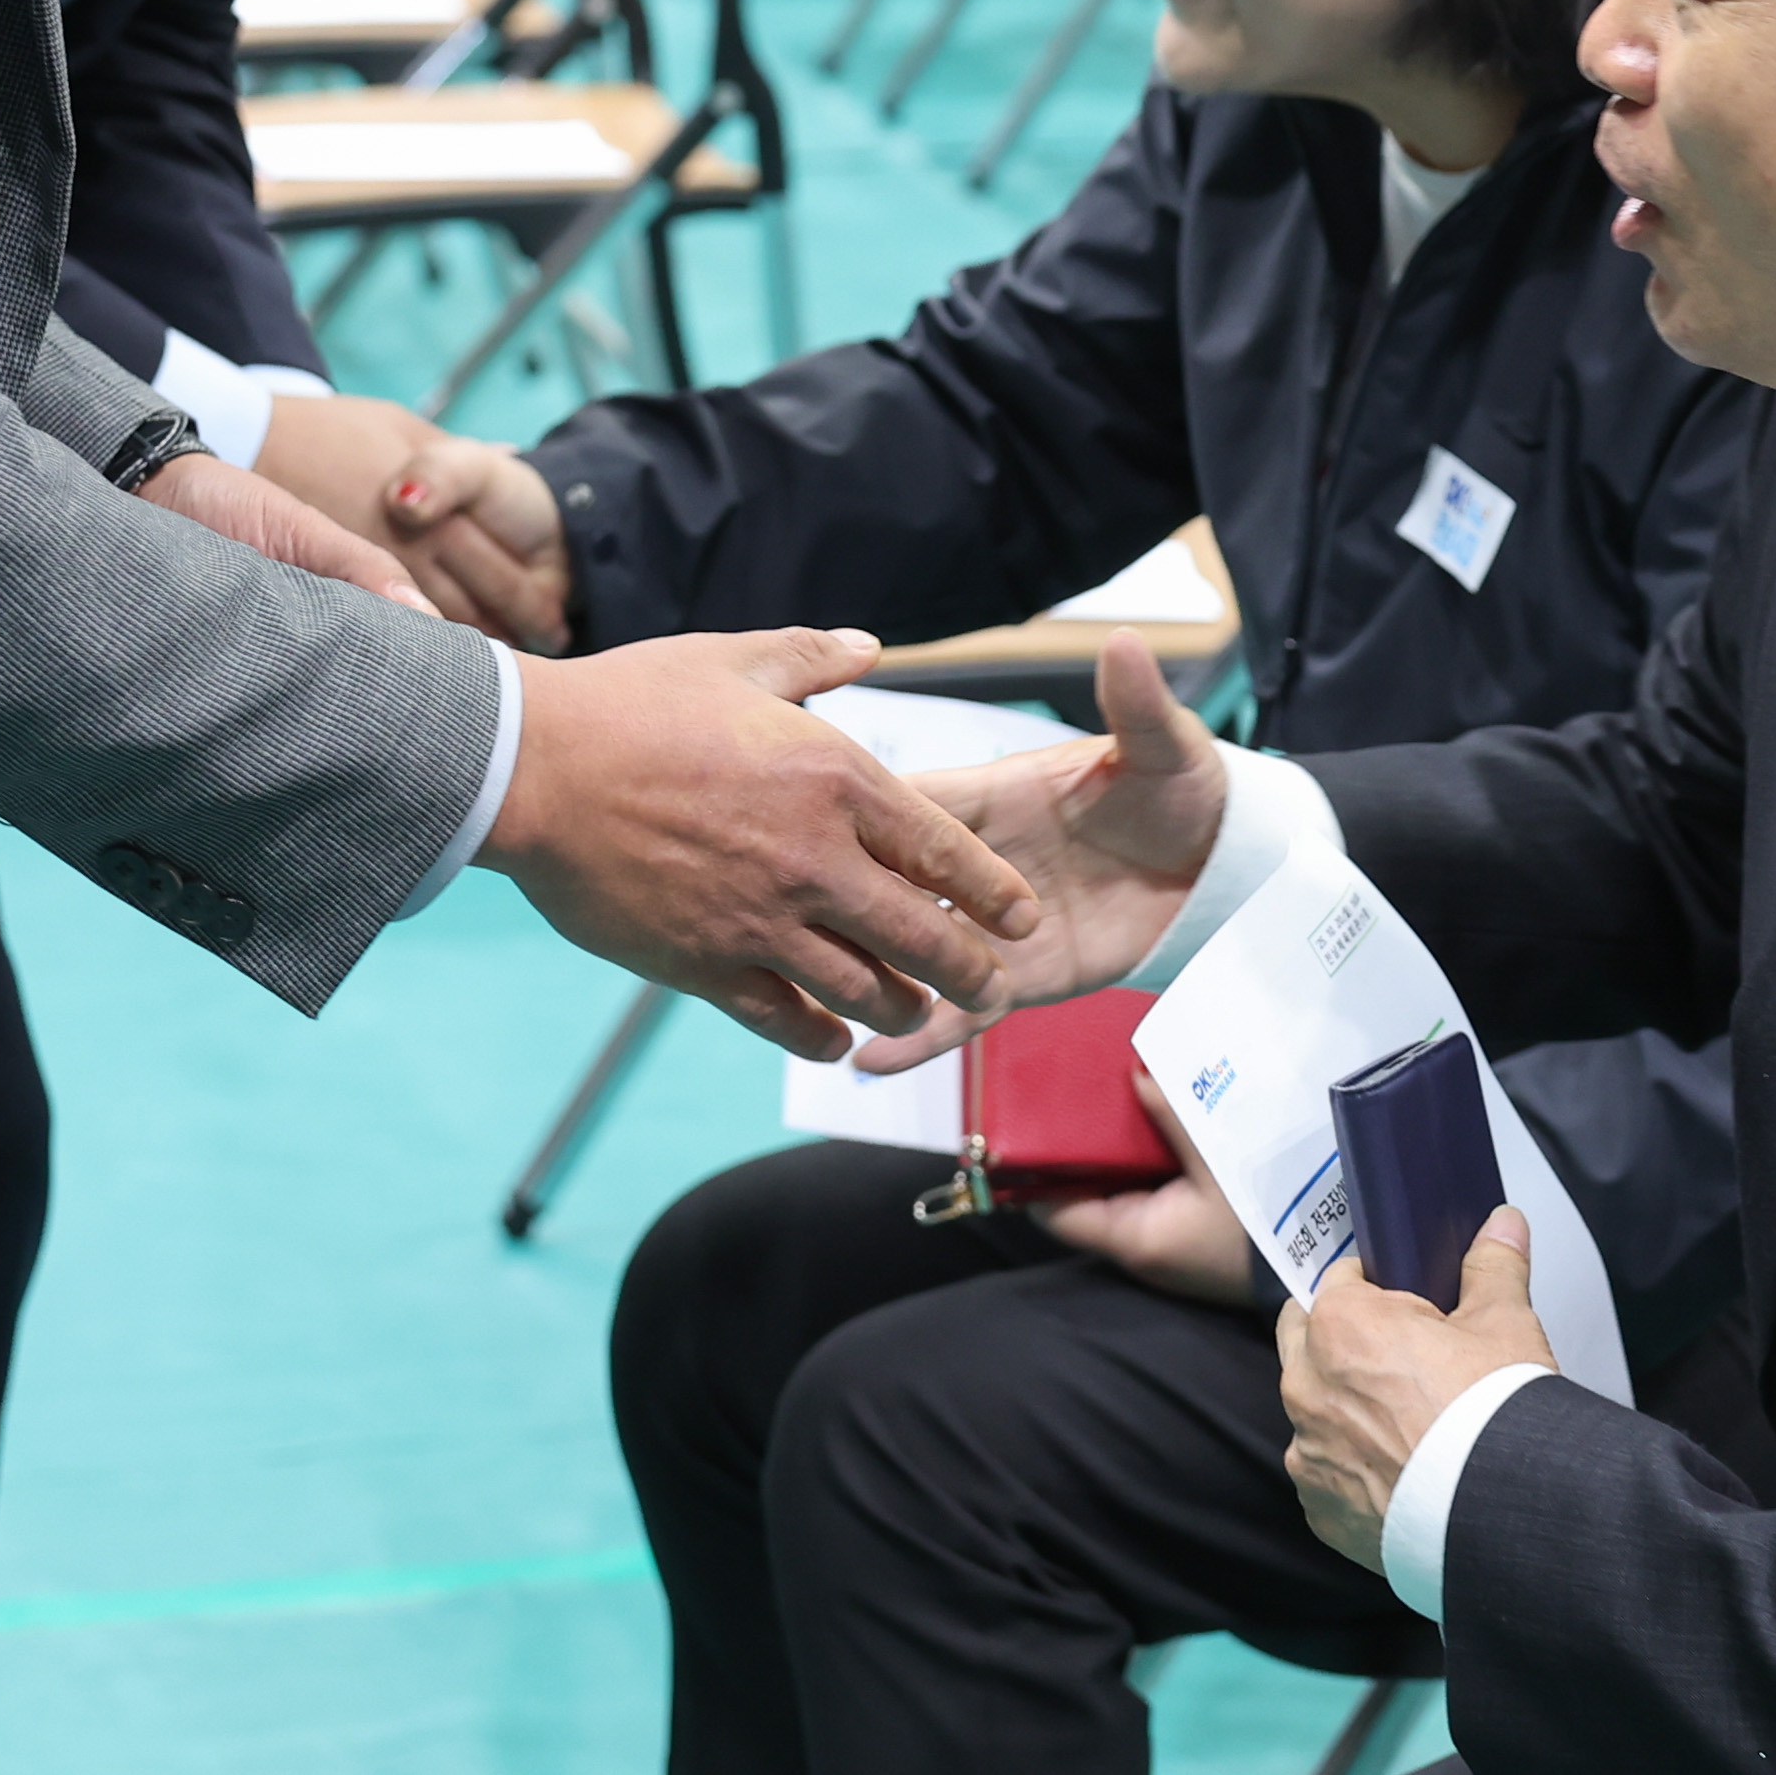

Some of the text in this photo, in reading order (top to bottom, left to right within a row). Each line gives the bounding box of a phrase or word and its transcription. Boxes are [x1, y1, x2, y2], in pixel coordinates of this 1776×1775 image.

[1192, 1054, 1230, 1101] OK! NOW
[1205, 1068, 1237, 1115] JEONNAM
[1287, 1223, 1318, 1269] 제45회
